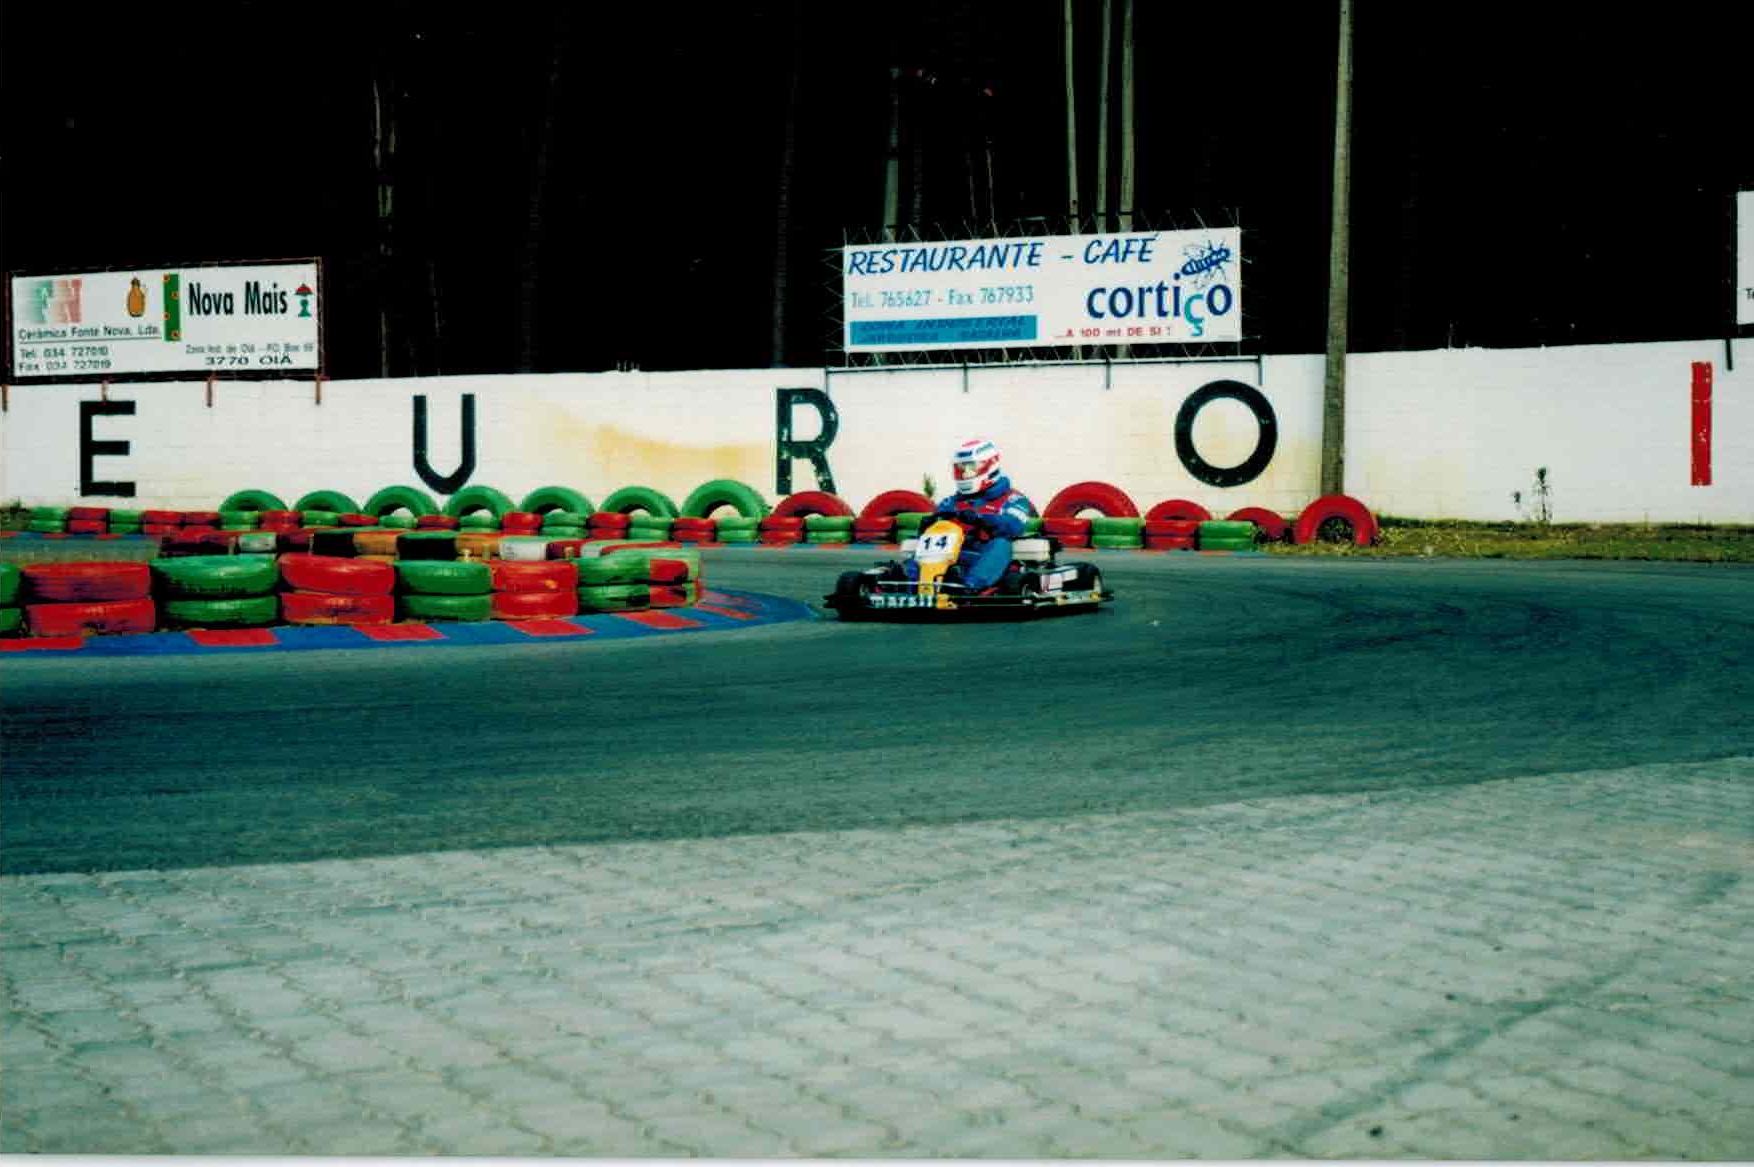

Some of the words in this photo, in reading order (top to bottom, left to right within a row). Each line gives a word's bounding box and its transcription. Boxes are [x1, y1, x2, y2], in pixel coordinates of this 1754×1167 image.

[849, 242, 1044, 275] RESTAURANTE
[1083, 233, 1159, 264] CAFÉ
[188, 282, 234, 316] Nova
[244, 280, 288, 315] Mais
[881, 290, 932, 307] 765627
[948, 289, 972, 305] Fax
[979, 286, 1034, 304] 767933
[1086, 272, 1232, 336] cortiço
[1127, 326, 1144, 336] DE
[205, 356, 250, 366] 3770
[922, 535, 948, 550] 14
